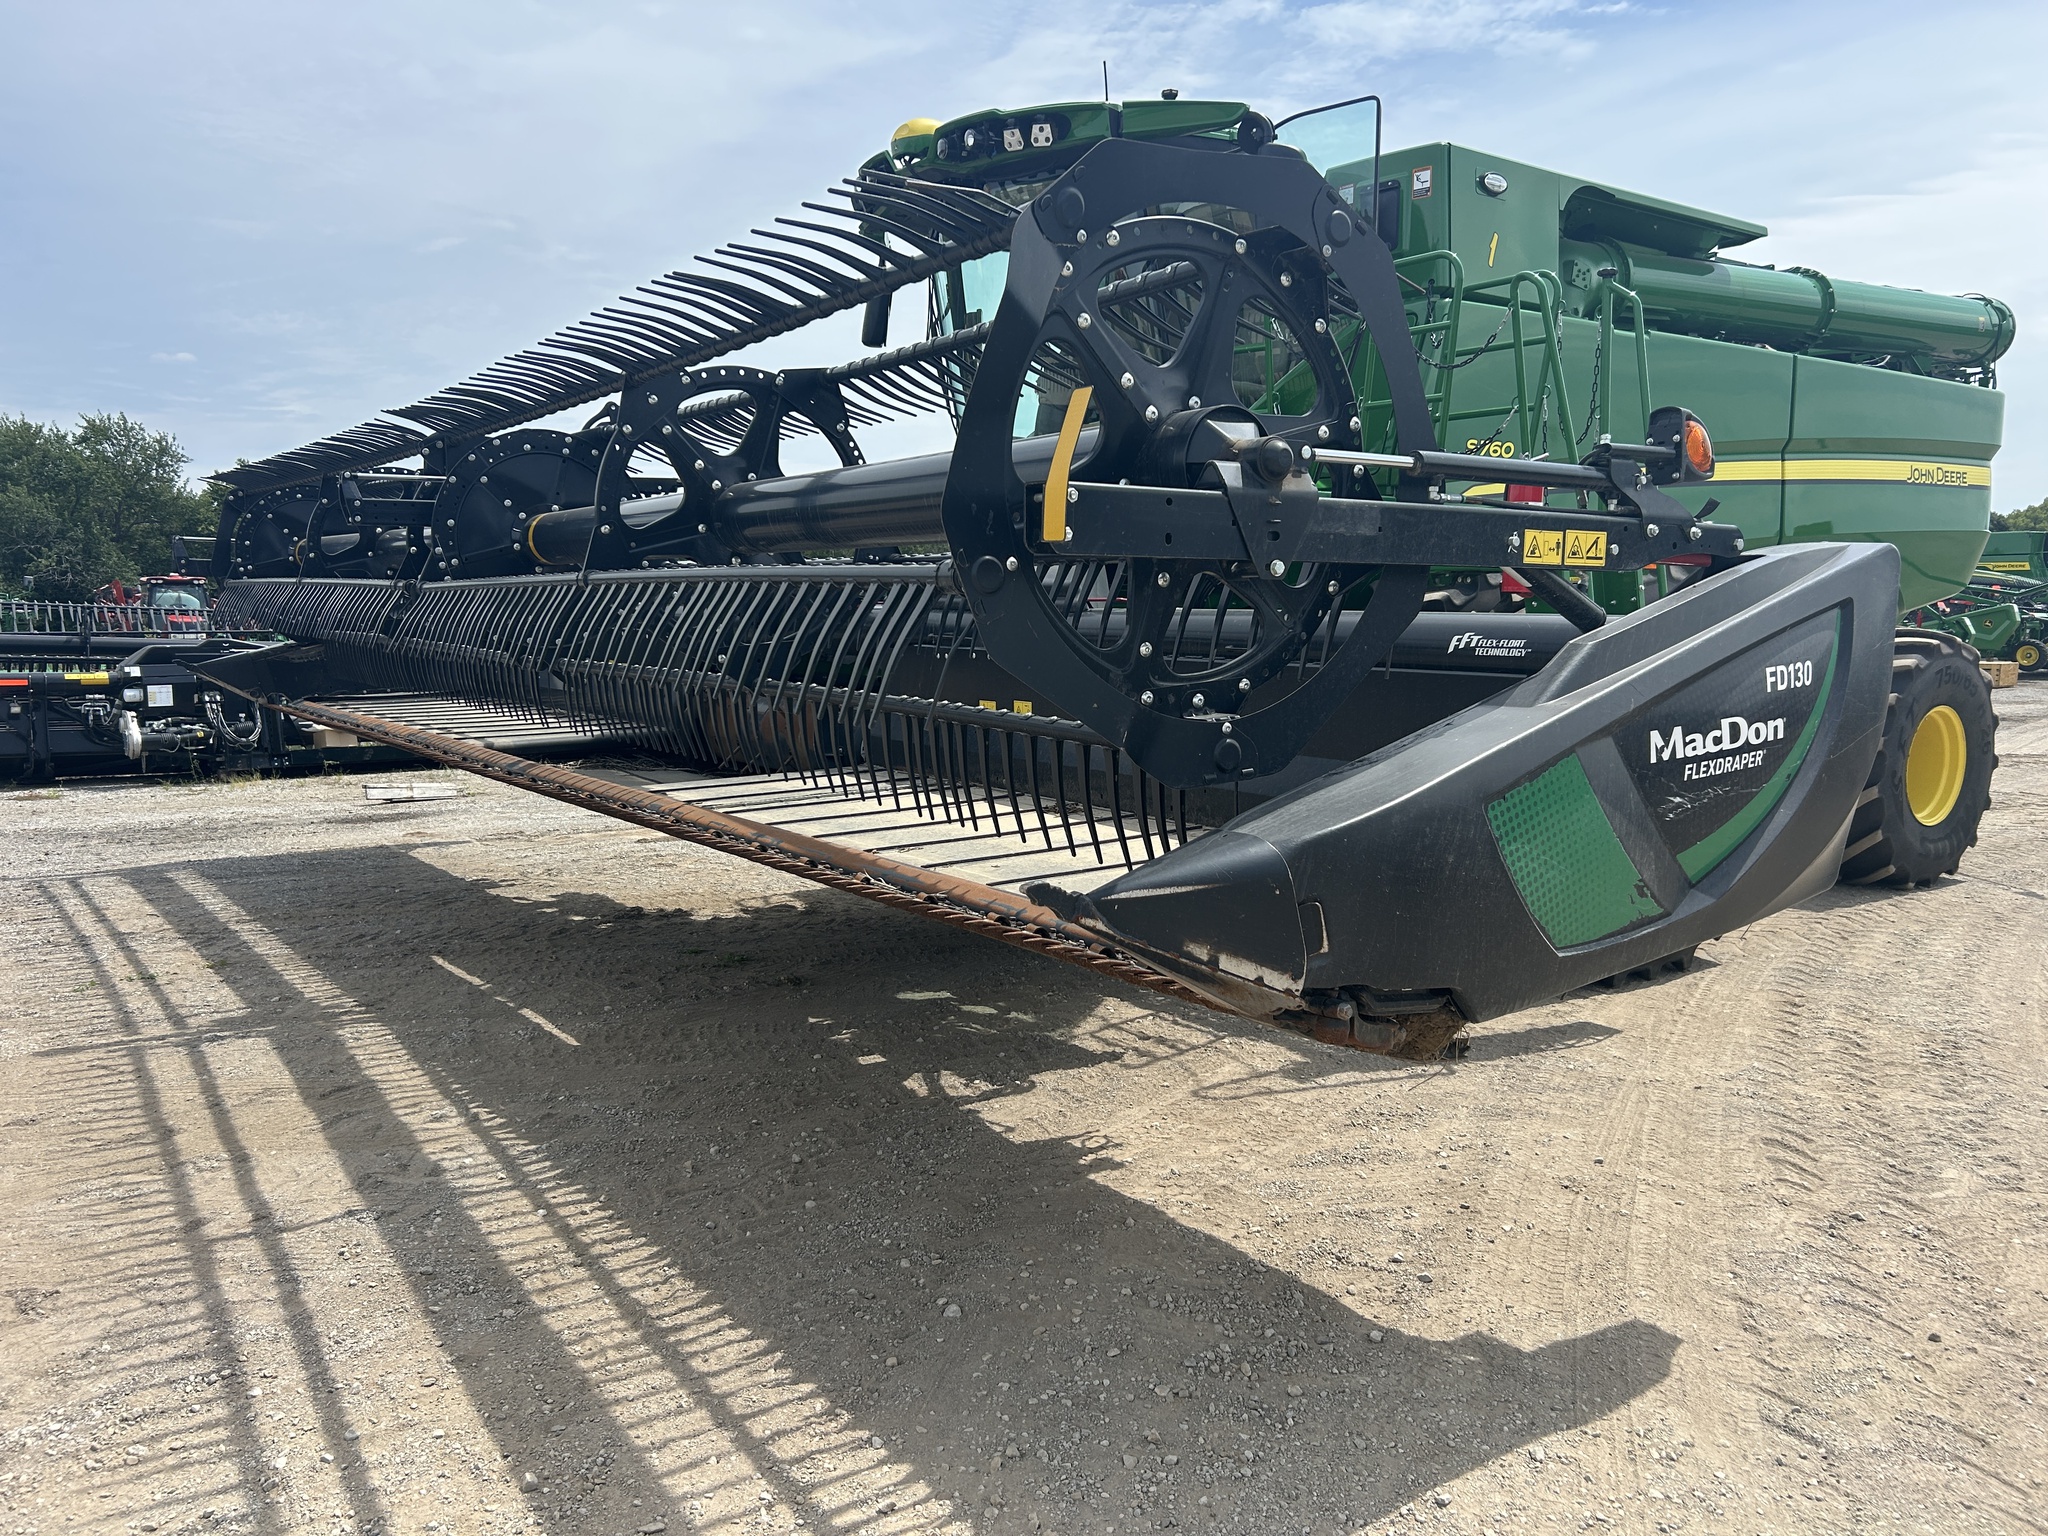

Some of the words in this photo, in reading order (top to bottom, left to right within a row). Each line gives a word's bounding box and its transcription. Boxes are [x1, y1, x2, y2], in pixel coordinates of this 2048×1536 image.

[1907, 465, 1935, 483] JOHN
[1936, 467, 1968, 485] DEERE
[1447, 632, 1483, 654] FFT
[1478, 639, 1527, 648] FLEX-FLOAT
[1766, 660, 1813, 693] FD130
[1650, 716, 1787, 764] MacDon
[1684, 749, 1767, 782] FLEXDRAPER
